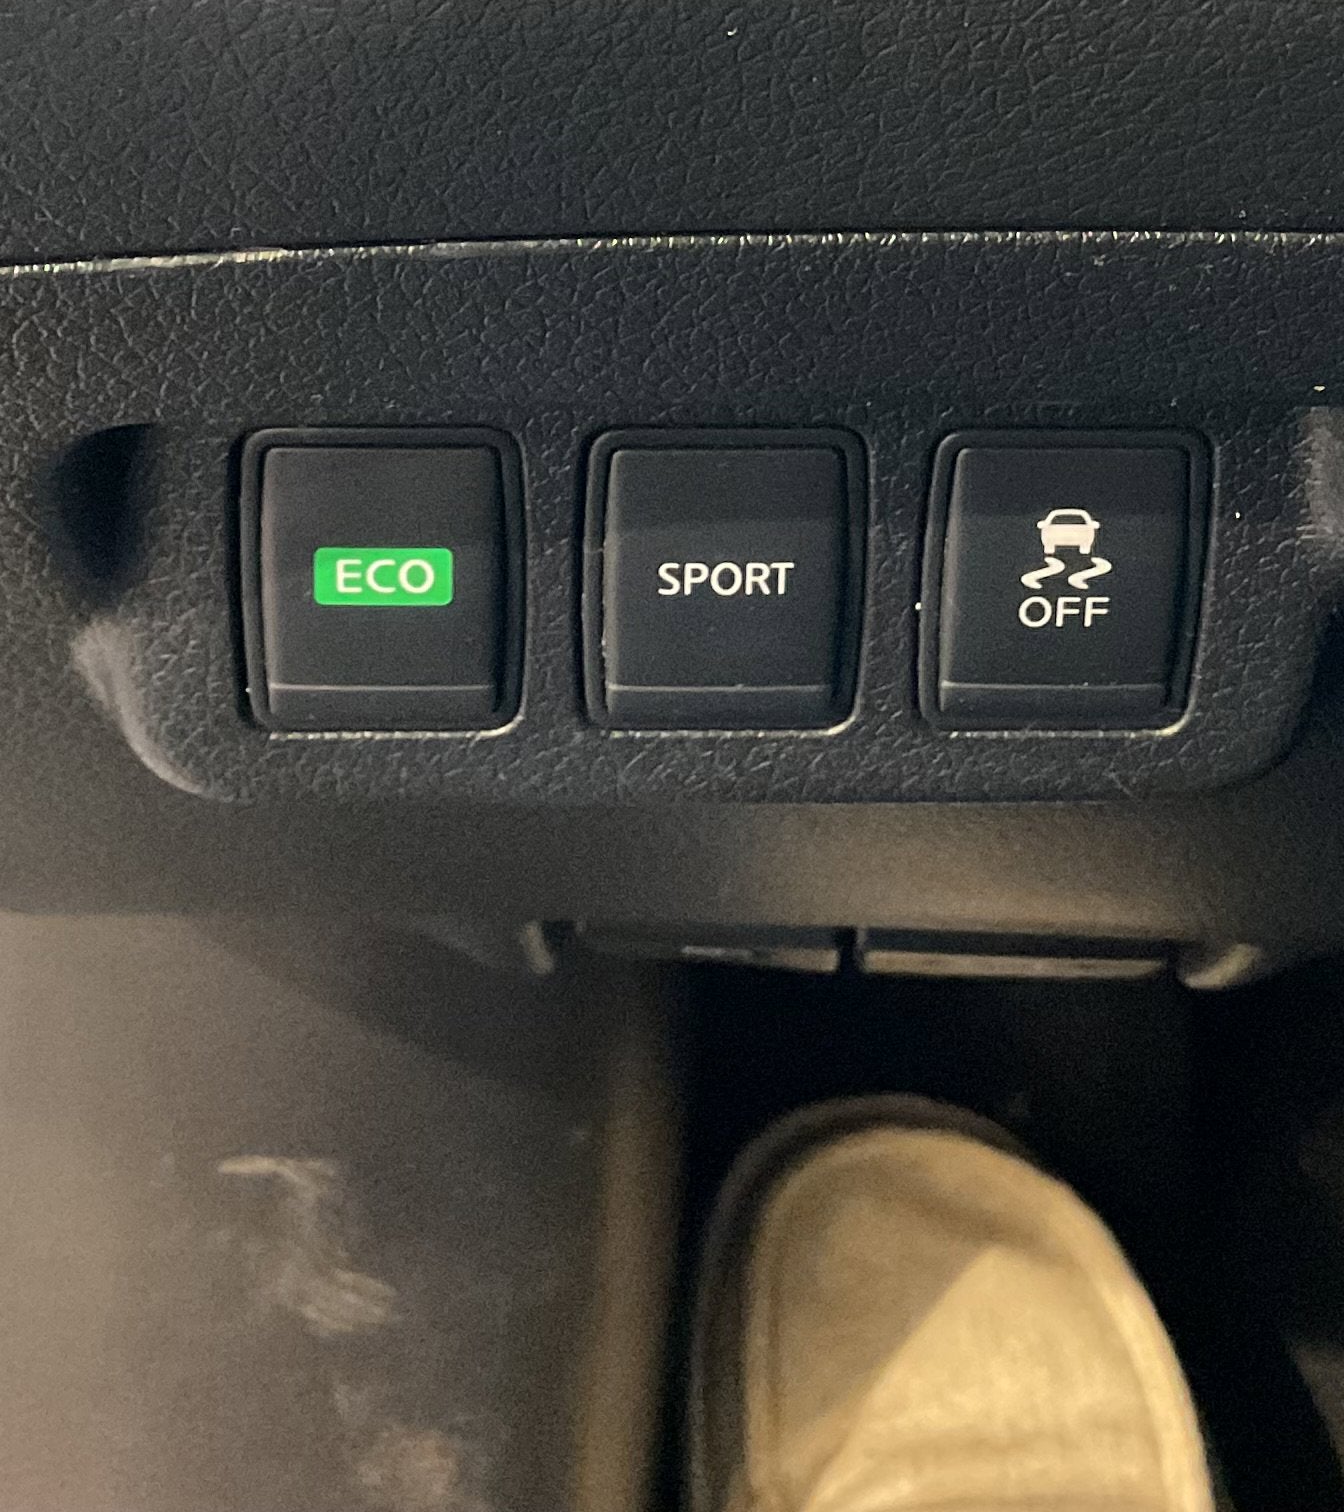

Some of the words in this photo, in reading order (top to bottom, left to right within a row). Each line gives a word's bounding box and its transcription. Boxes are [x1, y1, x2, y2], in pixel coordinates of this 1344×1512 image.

[335, 558, 435, 595] ECO
[657, 561, 795, 596] SPORT
[1018, 595, 1110, 628] OFF
